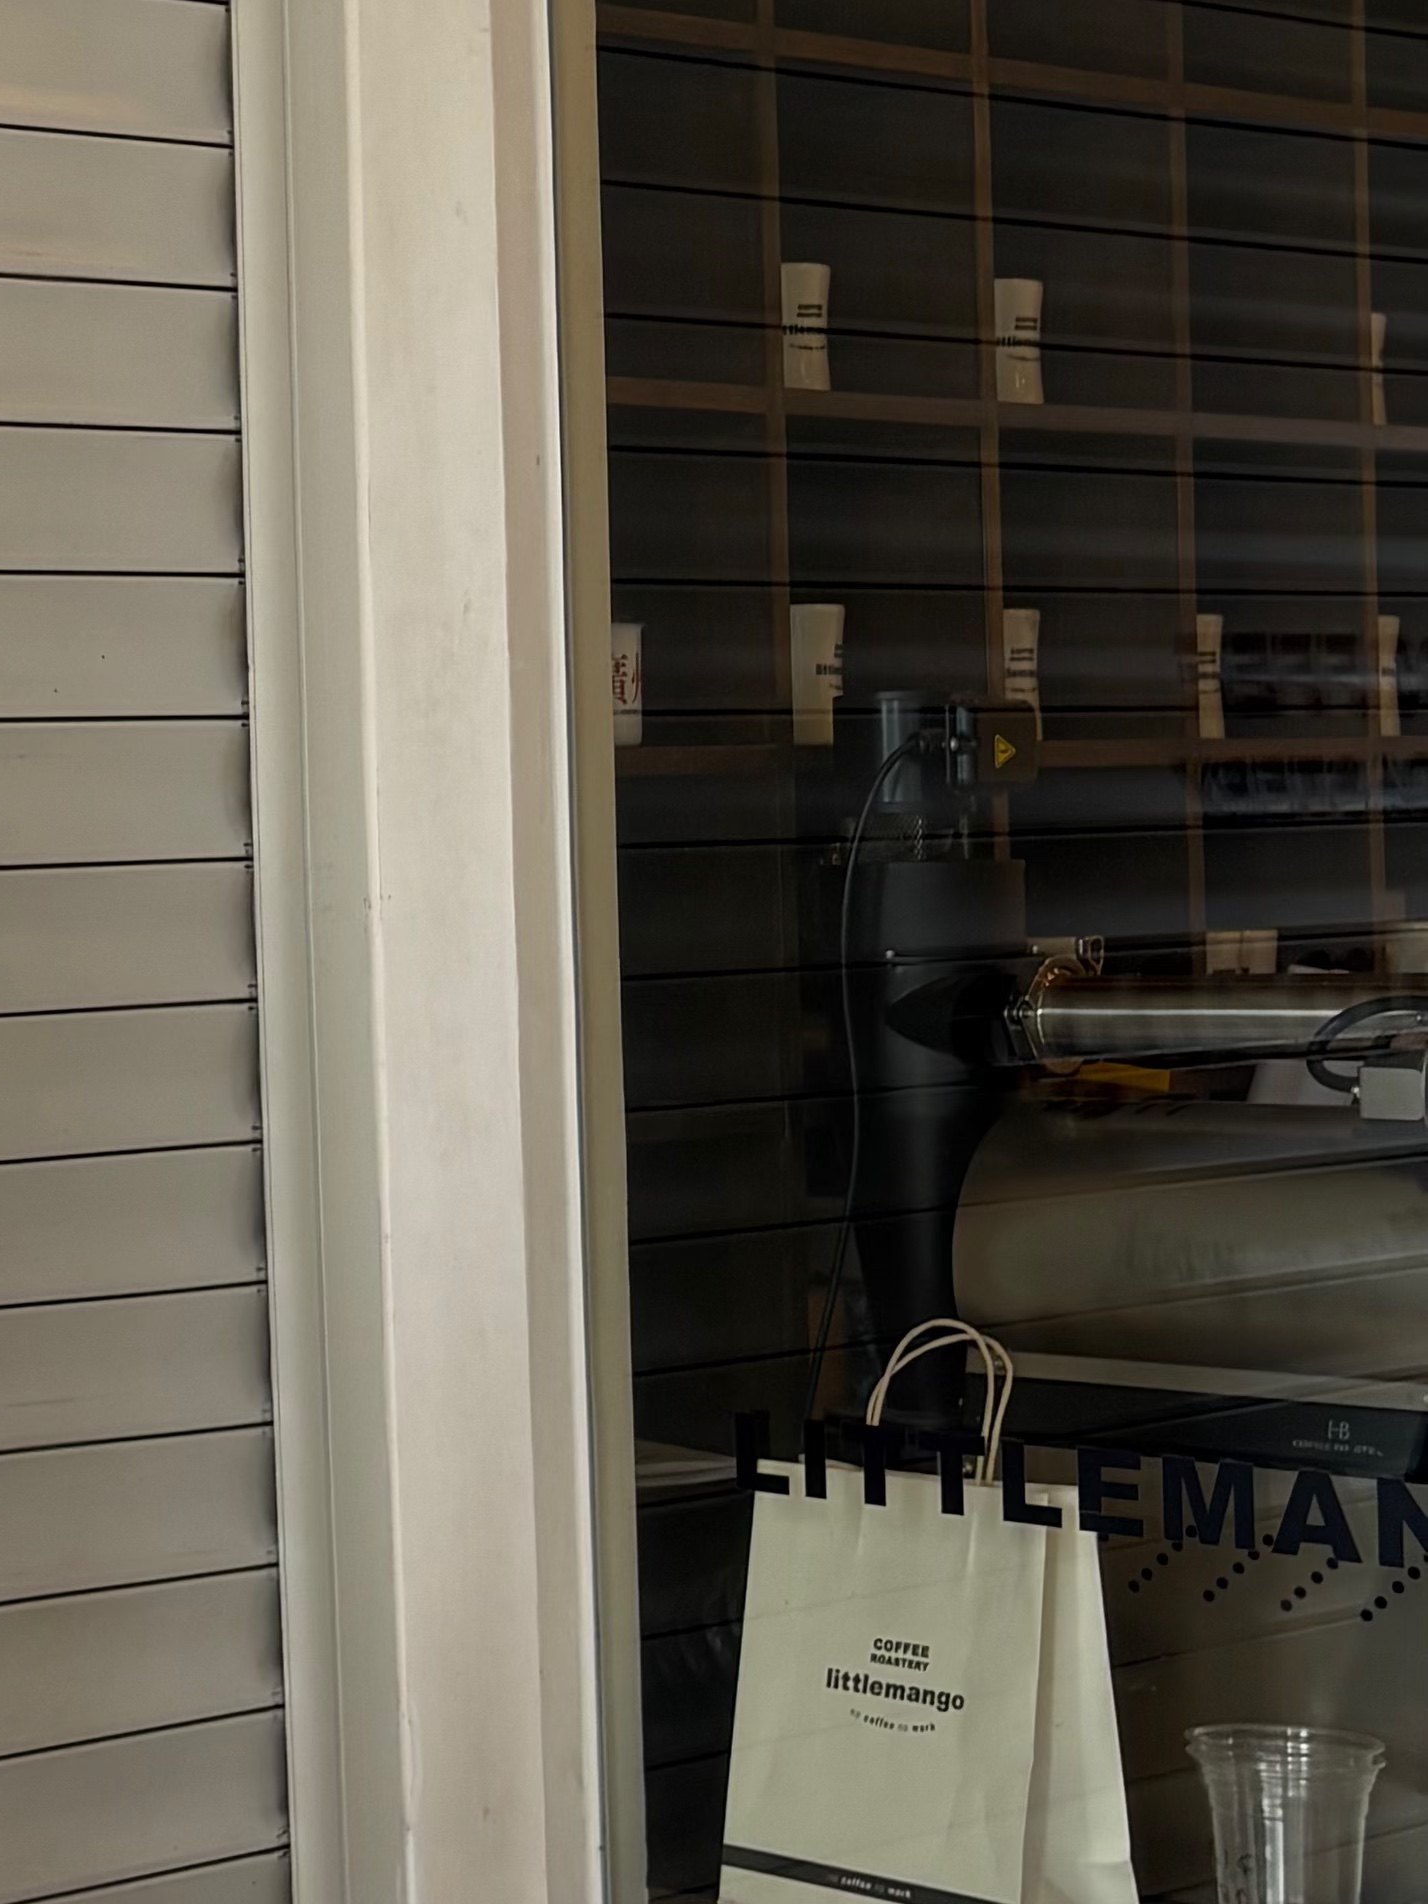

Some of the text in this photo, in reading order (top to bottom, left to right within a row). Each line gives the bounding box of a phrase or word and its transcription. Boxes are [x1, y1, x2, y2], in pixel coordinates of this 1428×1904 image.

[873, 1638, 930, 1658] COFFEE
[870, 1653, 929, 1672] ROASTERY
[826, 1667, 965, 1712] littlemango
